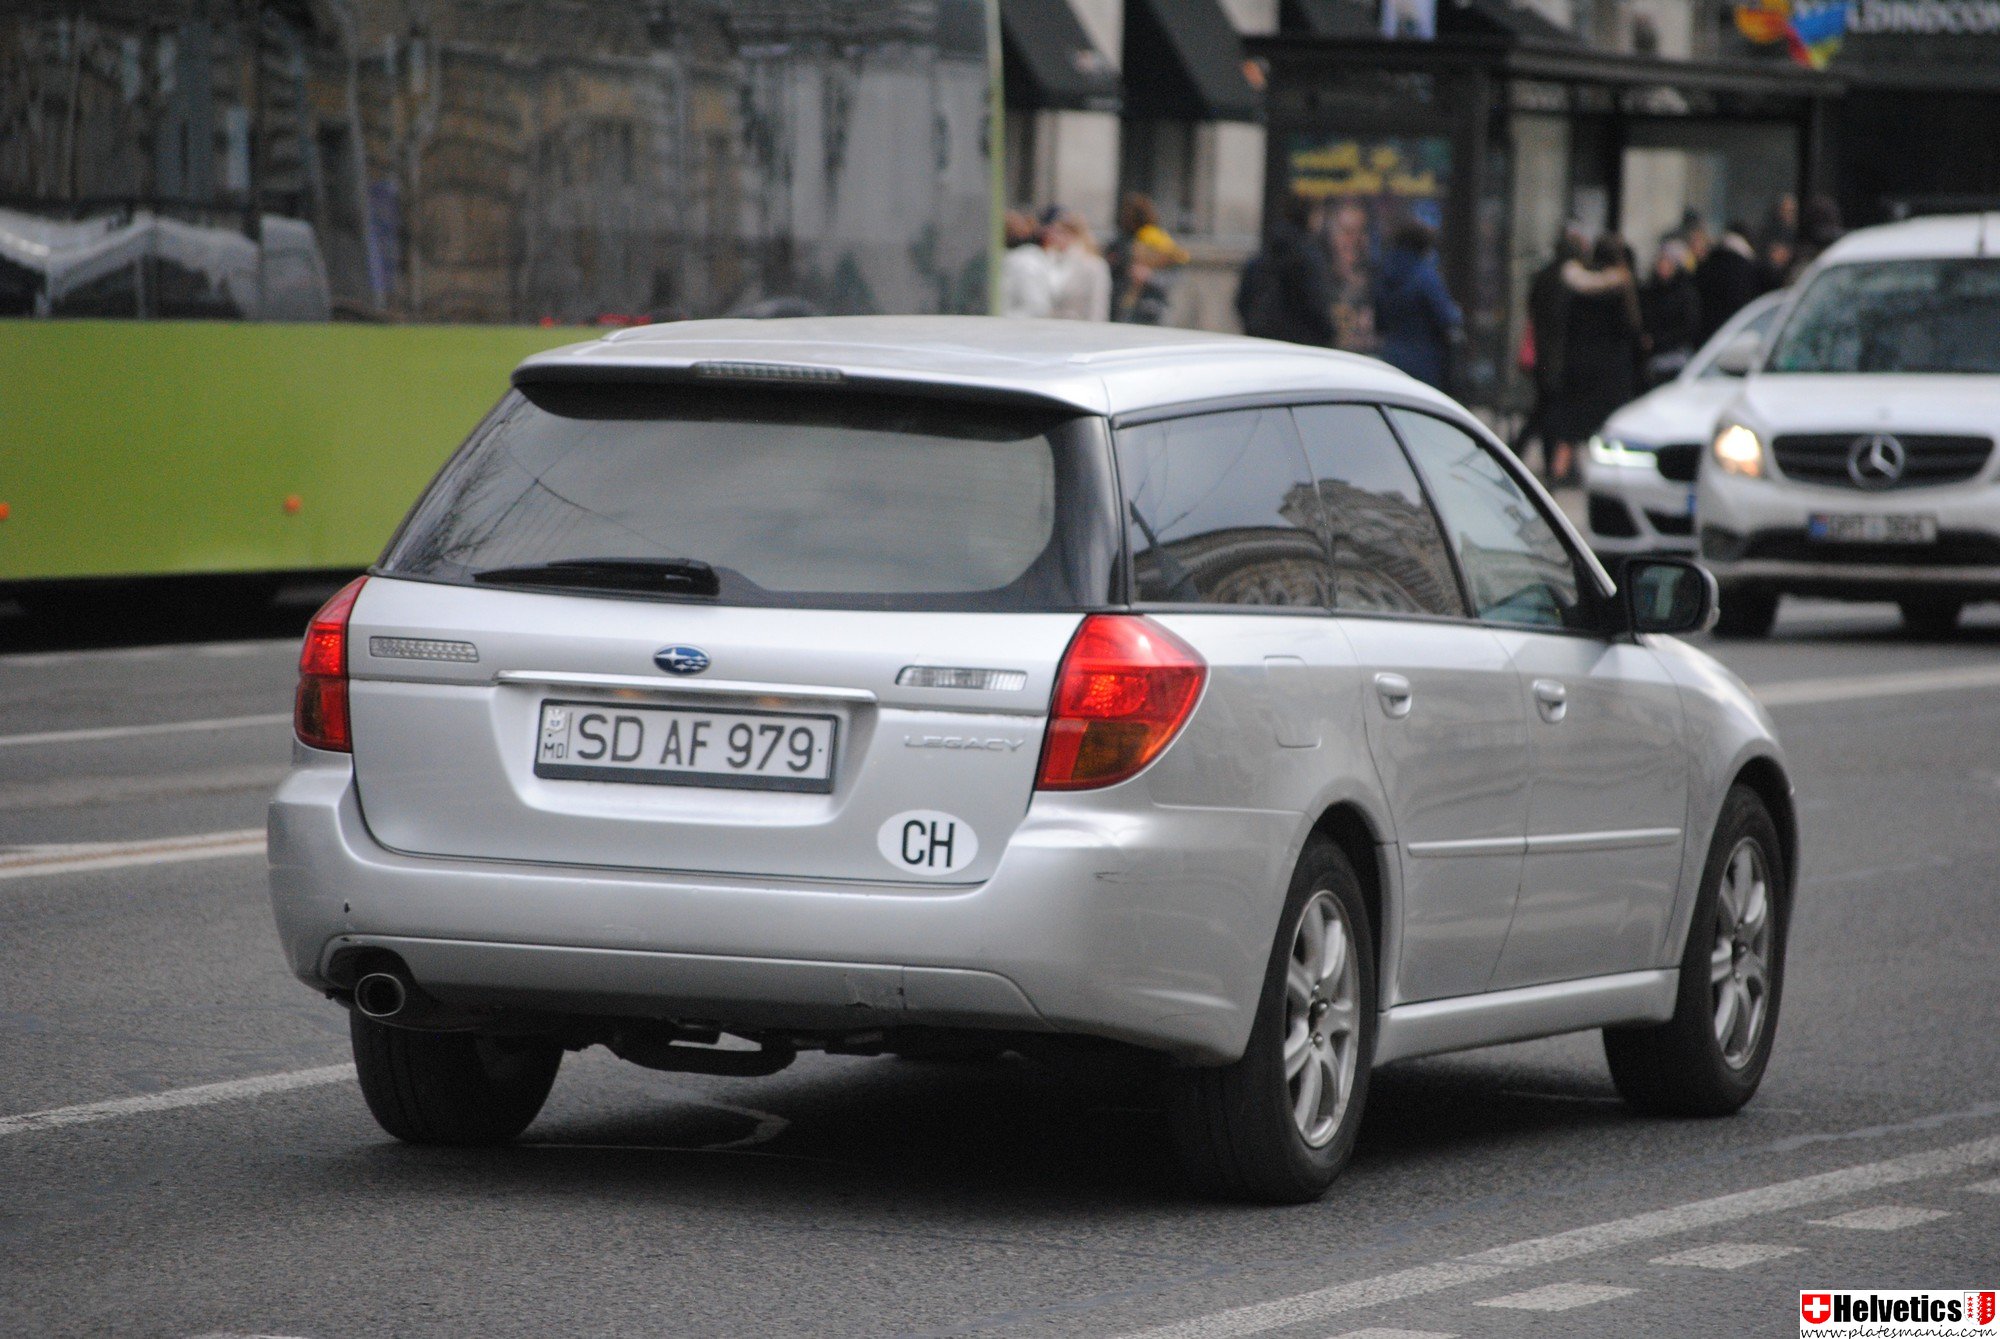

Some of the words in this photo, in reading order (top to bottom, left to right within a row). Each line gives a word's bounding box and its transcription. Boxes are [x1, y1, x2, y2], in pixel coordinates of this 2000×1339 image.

[543, 742, 565, 760] MD
[577, 713, 644, 762] SD
[660, 719, 711, 766] AF
[726, 722, 814, 772] 979
[904, 735, 1024, 751] LEGACY
[902, 819, 955, 868] CH
